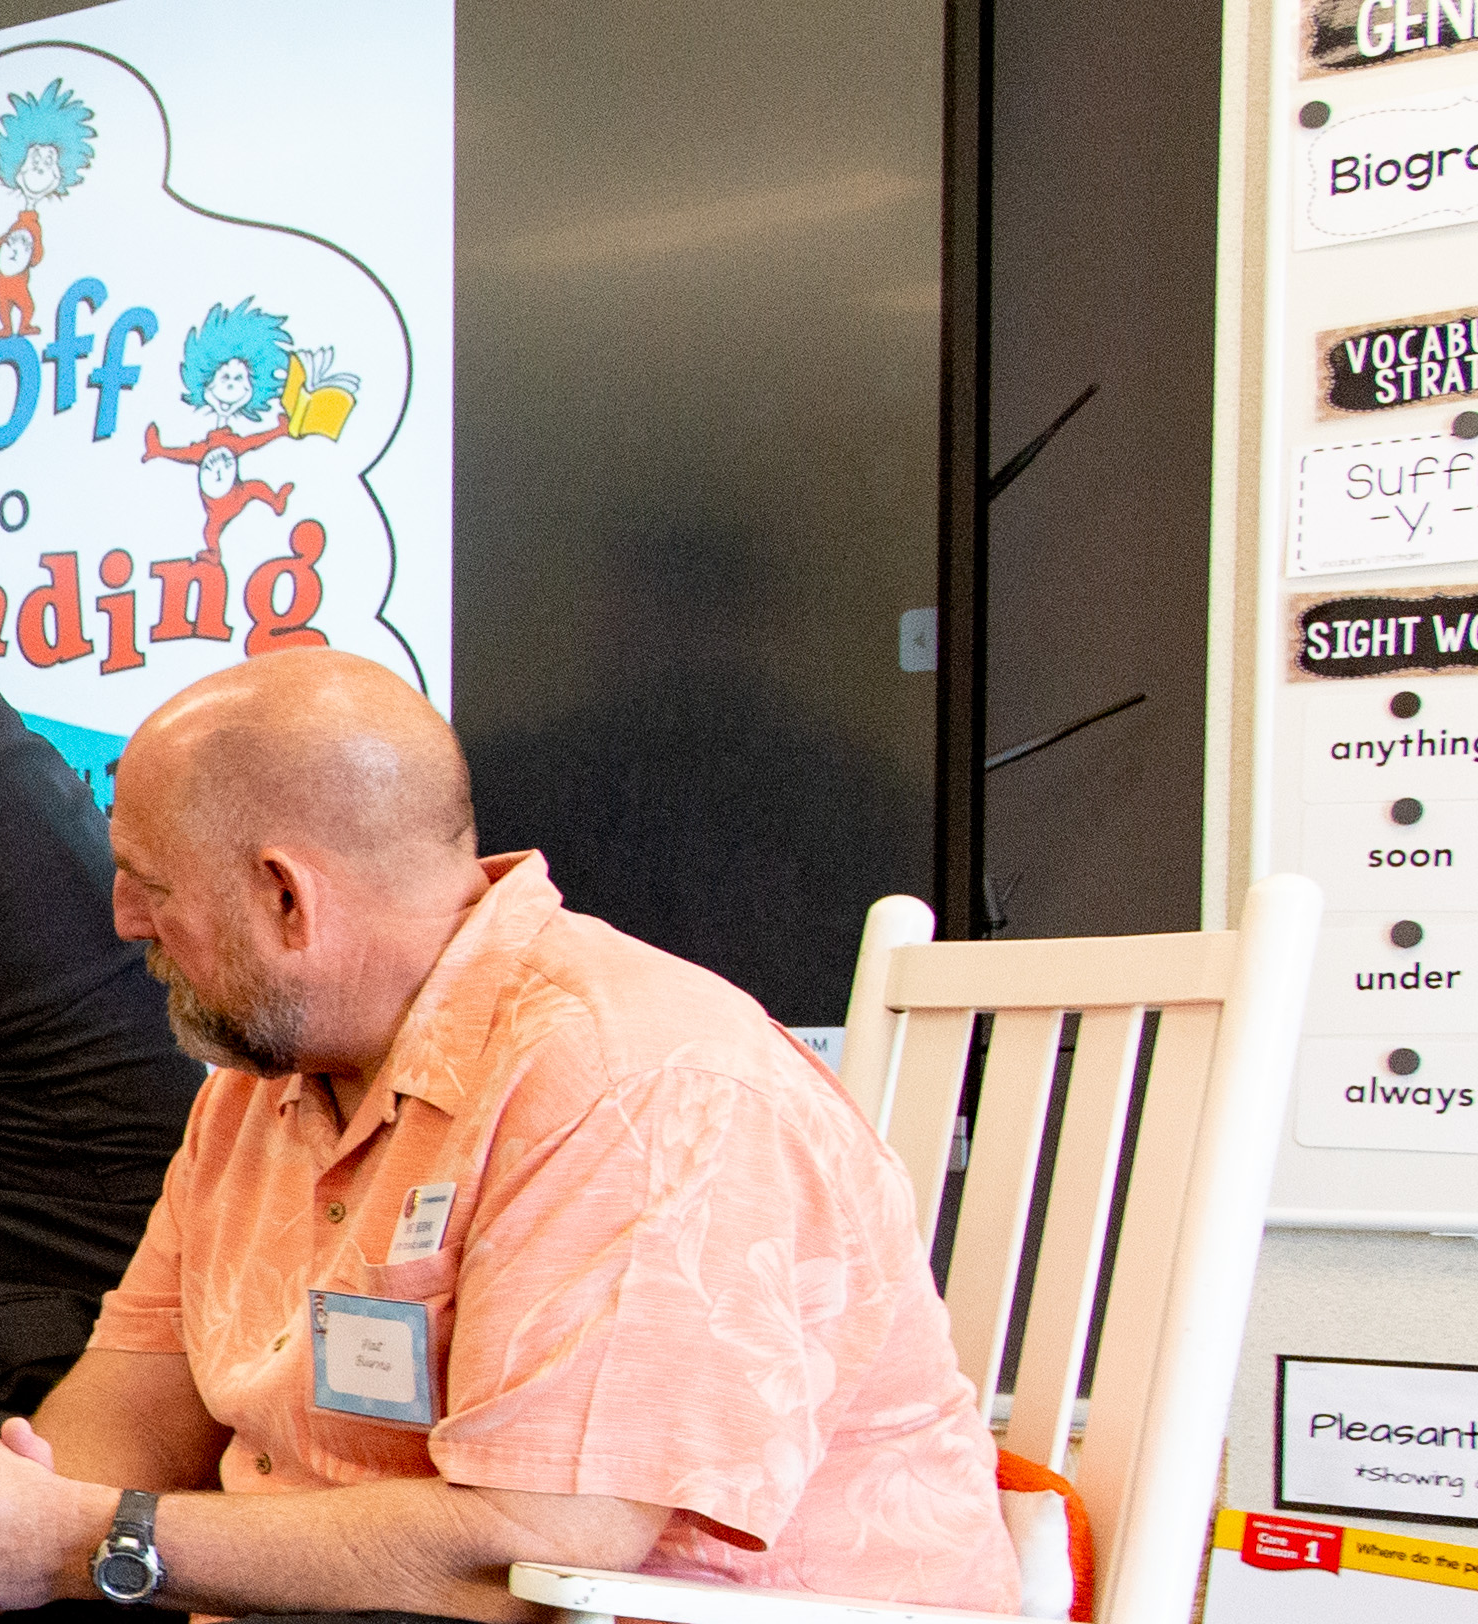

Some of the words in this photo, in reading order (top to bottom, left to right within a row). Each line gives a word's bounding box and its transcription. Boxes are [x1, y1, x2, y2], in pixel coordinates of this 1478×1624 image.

[1357, 0, 1478, 57] GEN
[1307, 615, 1423, 661] SIGHT
[1368, 846, 1454, 868] soon
[1356, 963, 1462, 991] under
[1345, 1076, 1474, 1114] always
[1310, 1412, 1478, 1449] Pleasant
[1257, 1532, 1290, 1547] Core
[1304, 1541, 1321, 1564] 1
[1357, 1542, 1407, 1562] Where
[1411, 1552, 1431, 1565] do
[1435, 1555, 1459, 1570] the
